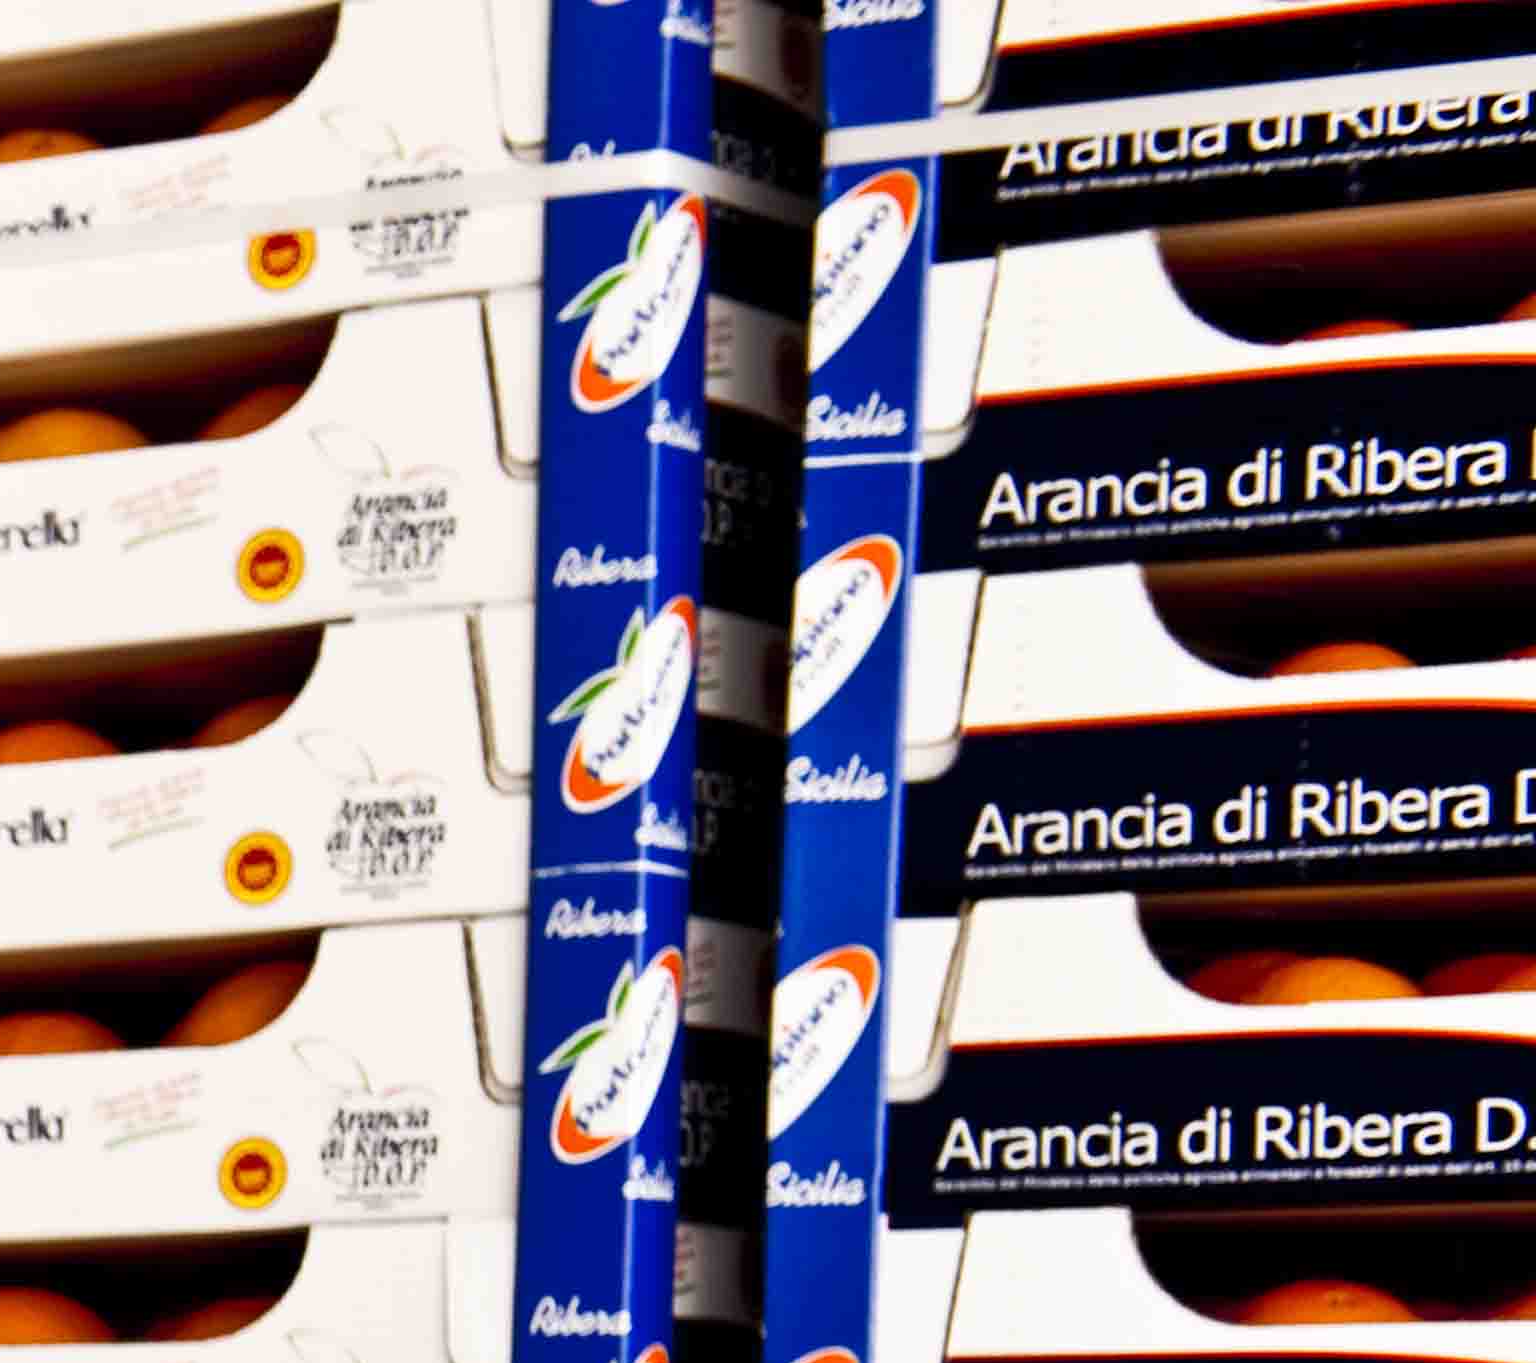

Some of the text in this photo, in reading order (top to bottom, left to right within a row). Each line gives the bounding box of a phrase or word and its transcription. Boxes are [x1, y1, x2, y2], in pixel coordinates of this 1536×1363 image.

[806, 393, 906, 442] Sicilia
[981, 438, 1506, 528] Arancia di Ribera
[553, 546, 657, 586] Ribera
[968, 778, 1490, 857] Arancia di Ribera
[937, 1102, 1452, 1171] Arancia di Ribera
[766, 1161, 865, 1207] Sicilia
[529, 1297, 632, 1337] Ribera
